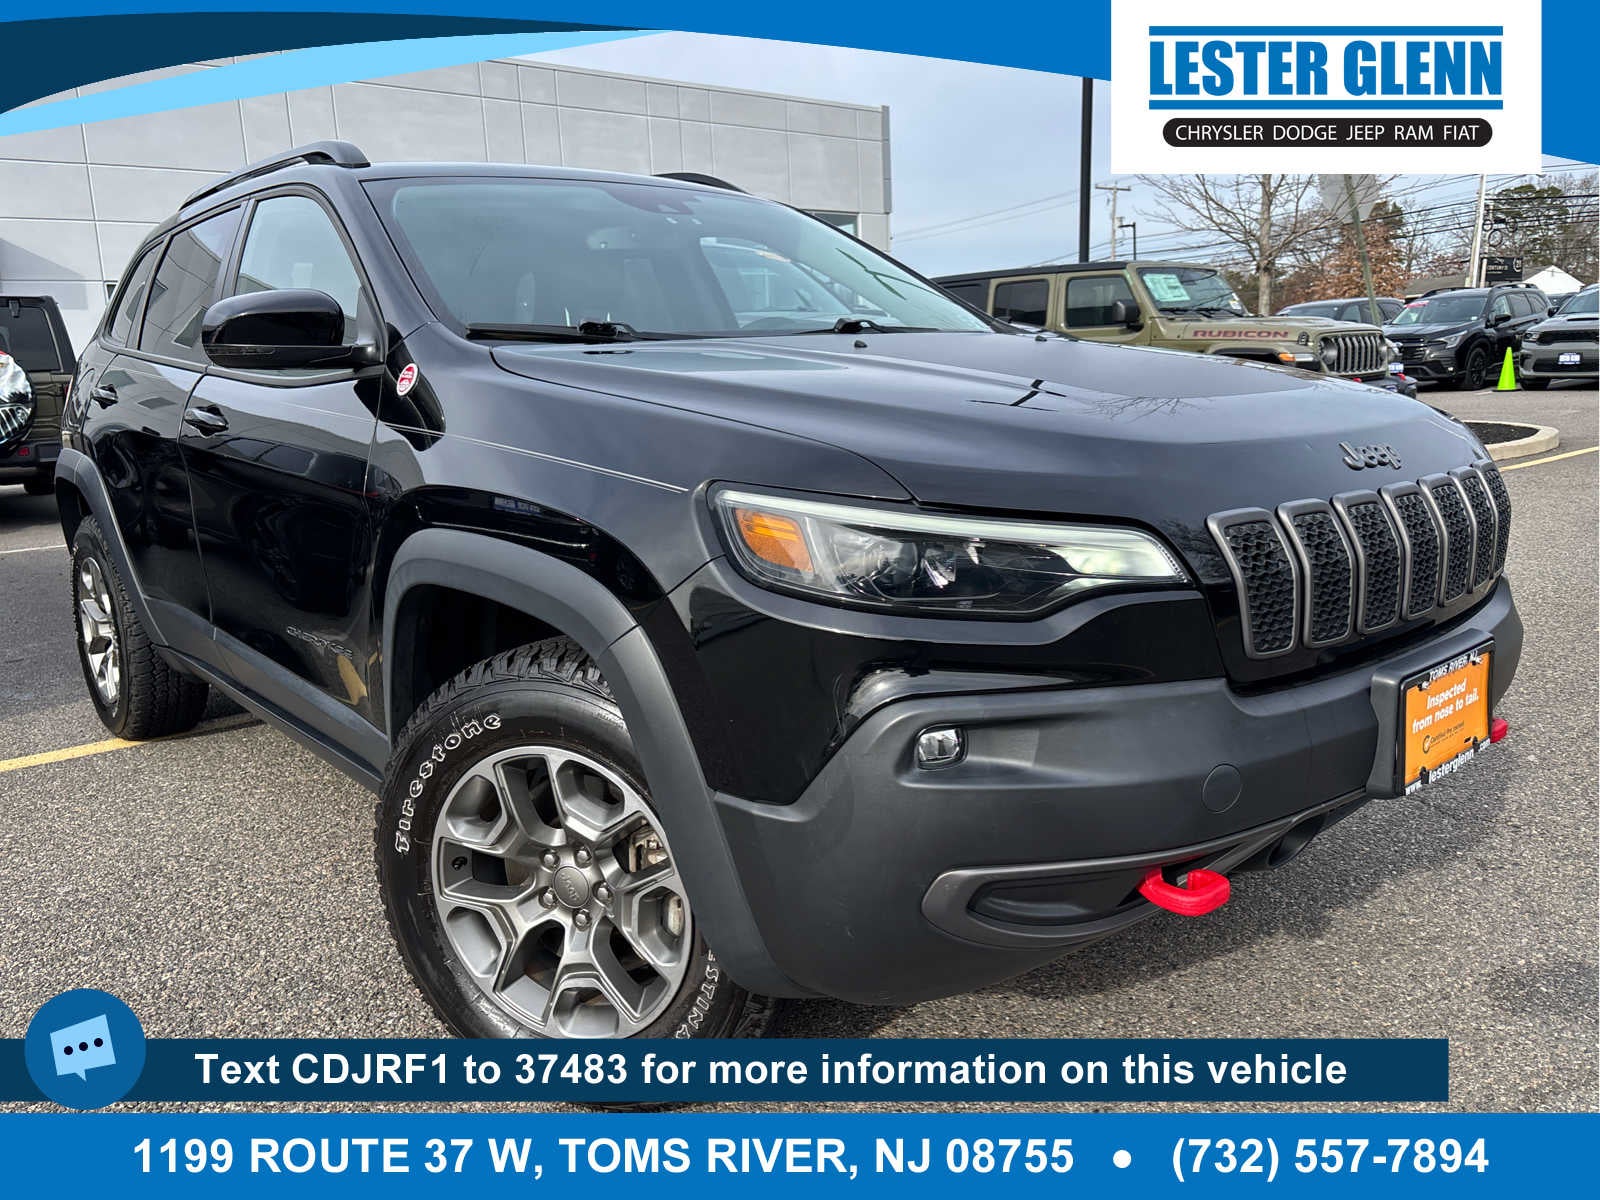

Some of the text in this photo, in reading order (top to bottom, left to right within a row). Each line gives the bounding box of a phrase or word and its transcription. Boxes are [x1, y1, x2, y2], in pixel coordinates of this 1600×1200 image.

[1193, 329, 1289, 338] RUBICON
[1339, 442, 1402, 471] Jeep
[1429, 664, 1448, 682] TOMS
[1426, 677, 1467, 710] Inspected
[1412, 687, 1479, 734] from nose to tail.
[395, 714, 501, 853] Firestone
[1428, 749, 1474, 785] lesterglenn
